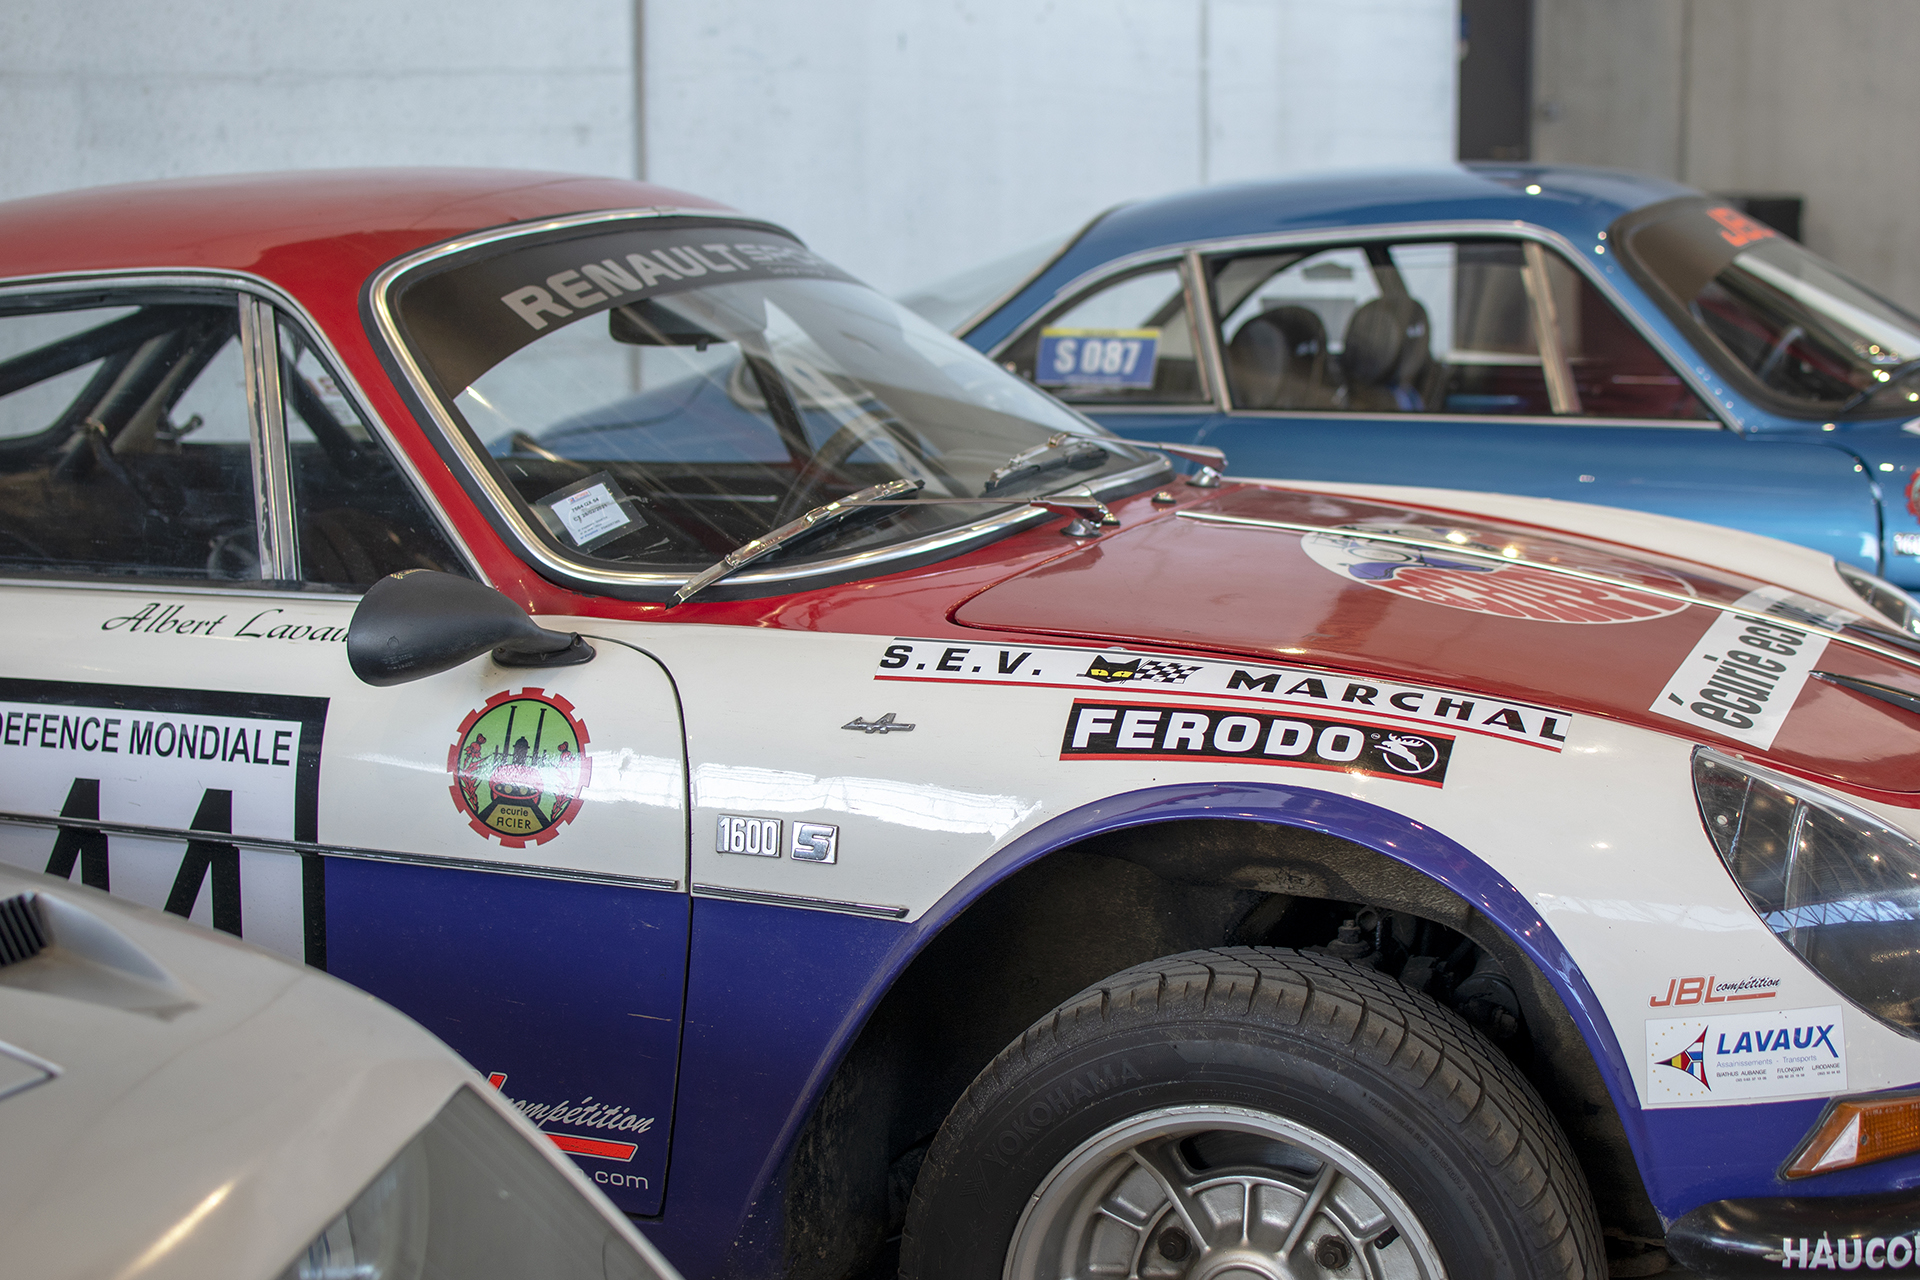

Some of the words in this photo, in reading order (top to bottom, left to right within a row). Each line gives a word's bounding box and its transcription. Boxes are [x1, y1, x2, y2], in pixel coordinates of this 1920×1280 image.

[501, 243, 750, 330] RENAULT
[1053, 339, 1077, 374] S
[1080, 340, 1141, 375] 087
[101, 603, 227, 637] Albert
[1226, 670, 1566, 743] MARCHAL
[0, 711, 121, 752] EFENCE
[129, 720, 293, 766] MONDIALE
[1071, 708, 1365, 761] FERODO
[496, 817, 531, 830] ACIER
[500, 806, 529, 817] ecurie
[718, 816, 779, 856] 1600
[1649, 976, 1725, 1008] JBL
[1715, 976, 1780, 994] compétition
[1716, 1024, 1839, 1058] LAVAUX
[1783, 1055, 1817, 1063] Transports
[508, 1096, 655, 1133] ompétition
[983, 1058, 1143, 1168] YOKOHAMA
[1782, 1236, 1920, 1270] HAUCO
